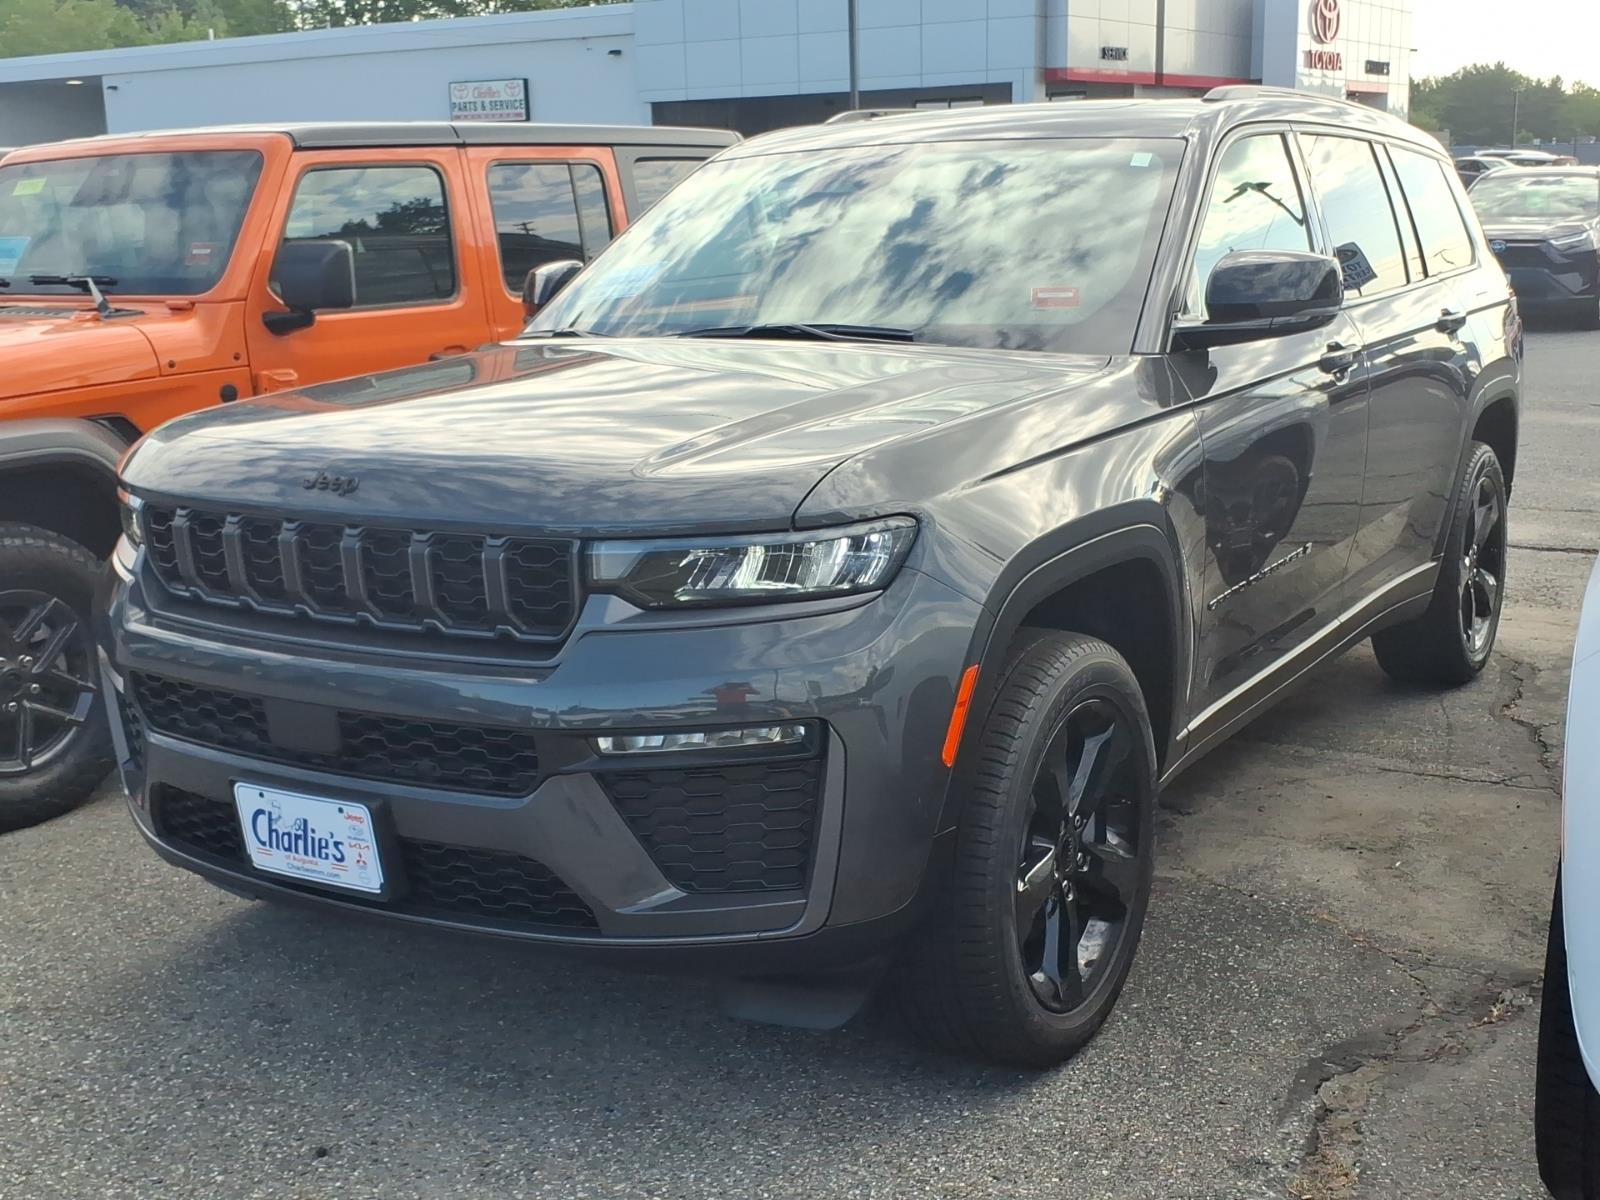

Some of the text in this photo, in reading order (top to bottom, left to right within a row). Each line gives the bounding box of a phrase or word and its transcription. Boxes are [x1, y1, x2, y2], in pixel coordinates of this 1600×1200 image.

[1309, 50, 1342, 70] TOYOTA
[452, 99, 525, 113] PARTS & SERVICE
[303, 472, 359, 496] Jeep
[251, 808, 346, 863] Charlie's
